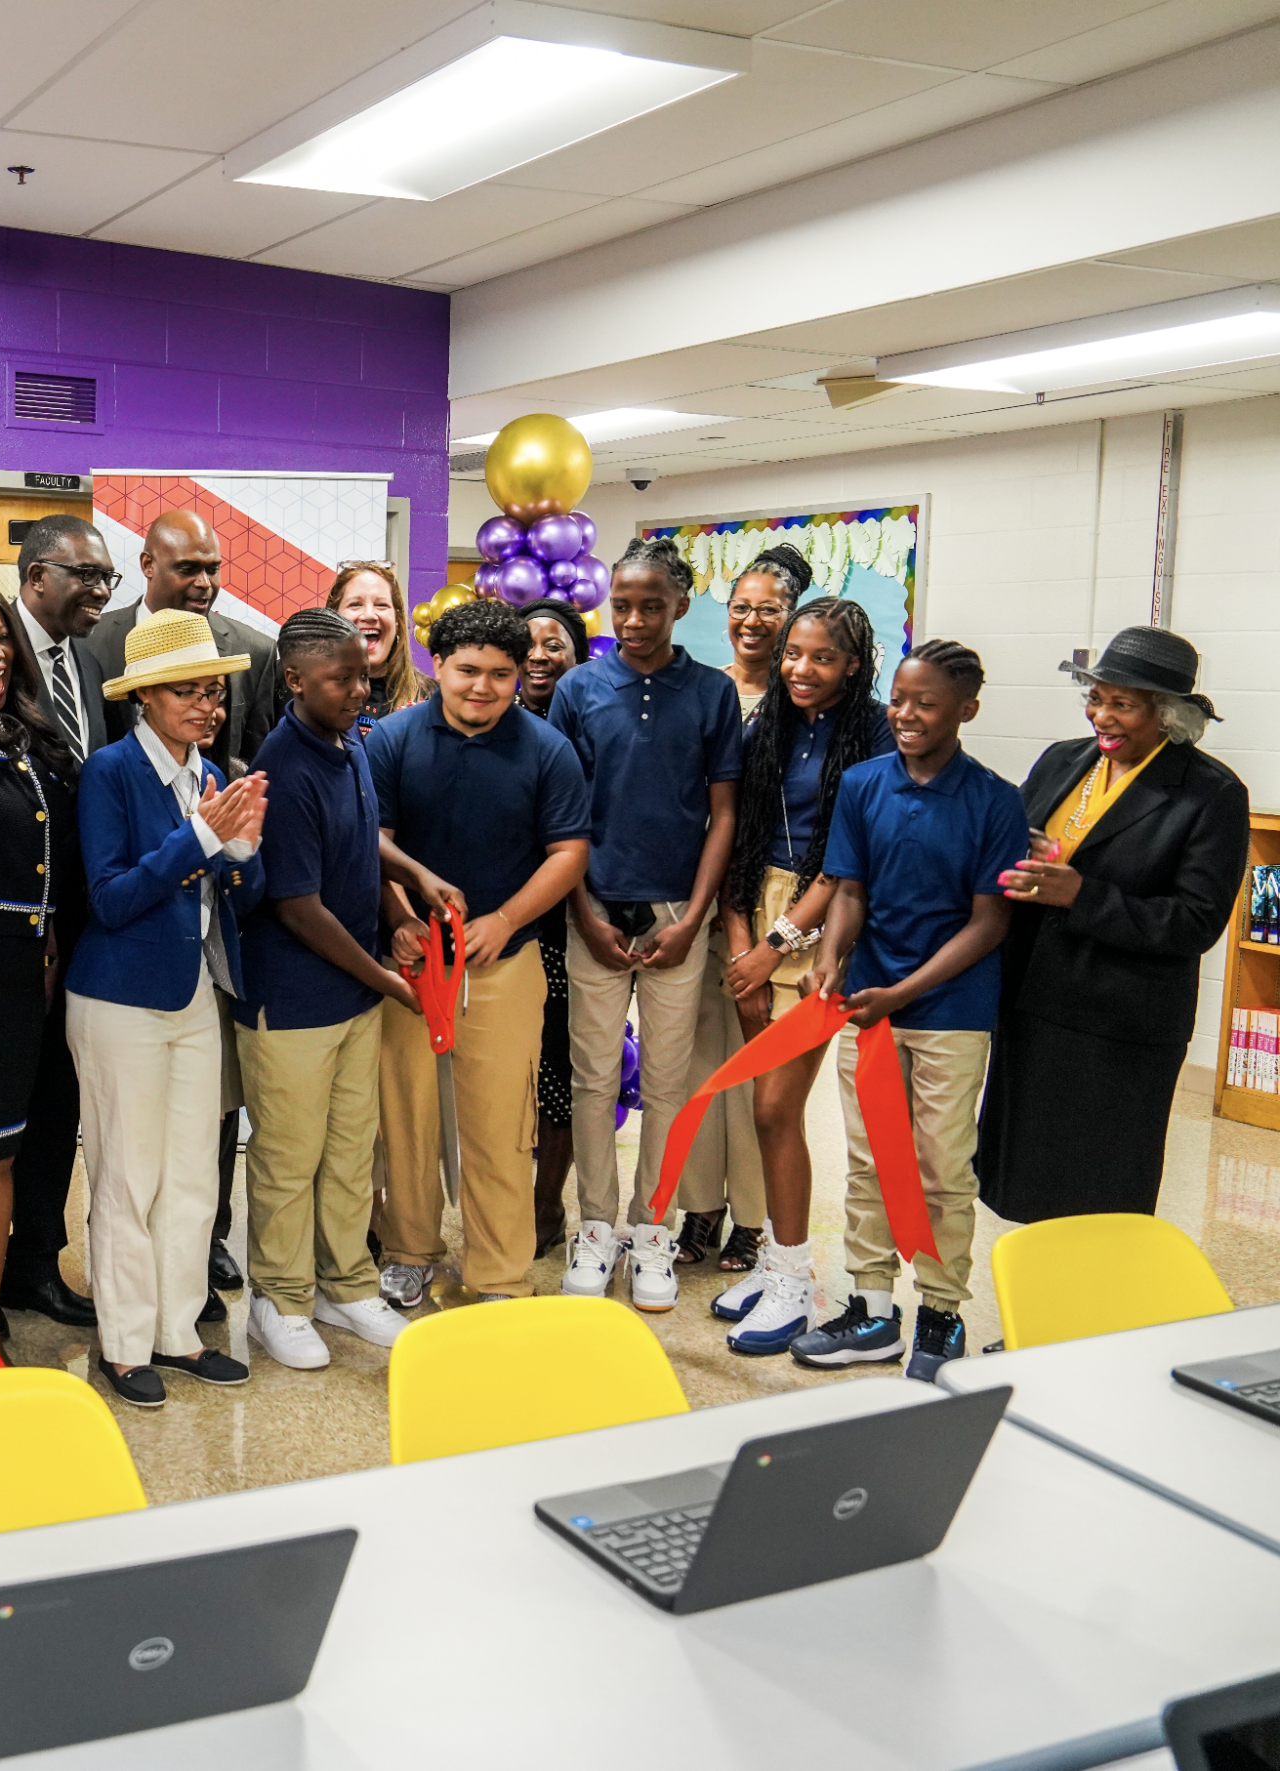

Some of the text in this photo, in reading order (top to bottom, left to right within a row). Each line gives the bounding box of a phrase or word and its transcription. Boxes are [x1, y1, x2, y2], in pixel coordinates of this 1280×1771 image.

[34, 474, 72, 488] FACULTY
[1153, 420, 1172, 628] FIRE EXTINGUISHE
[356, 715, 377, 726] me
